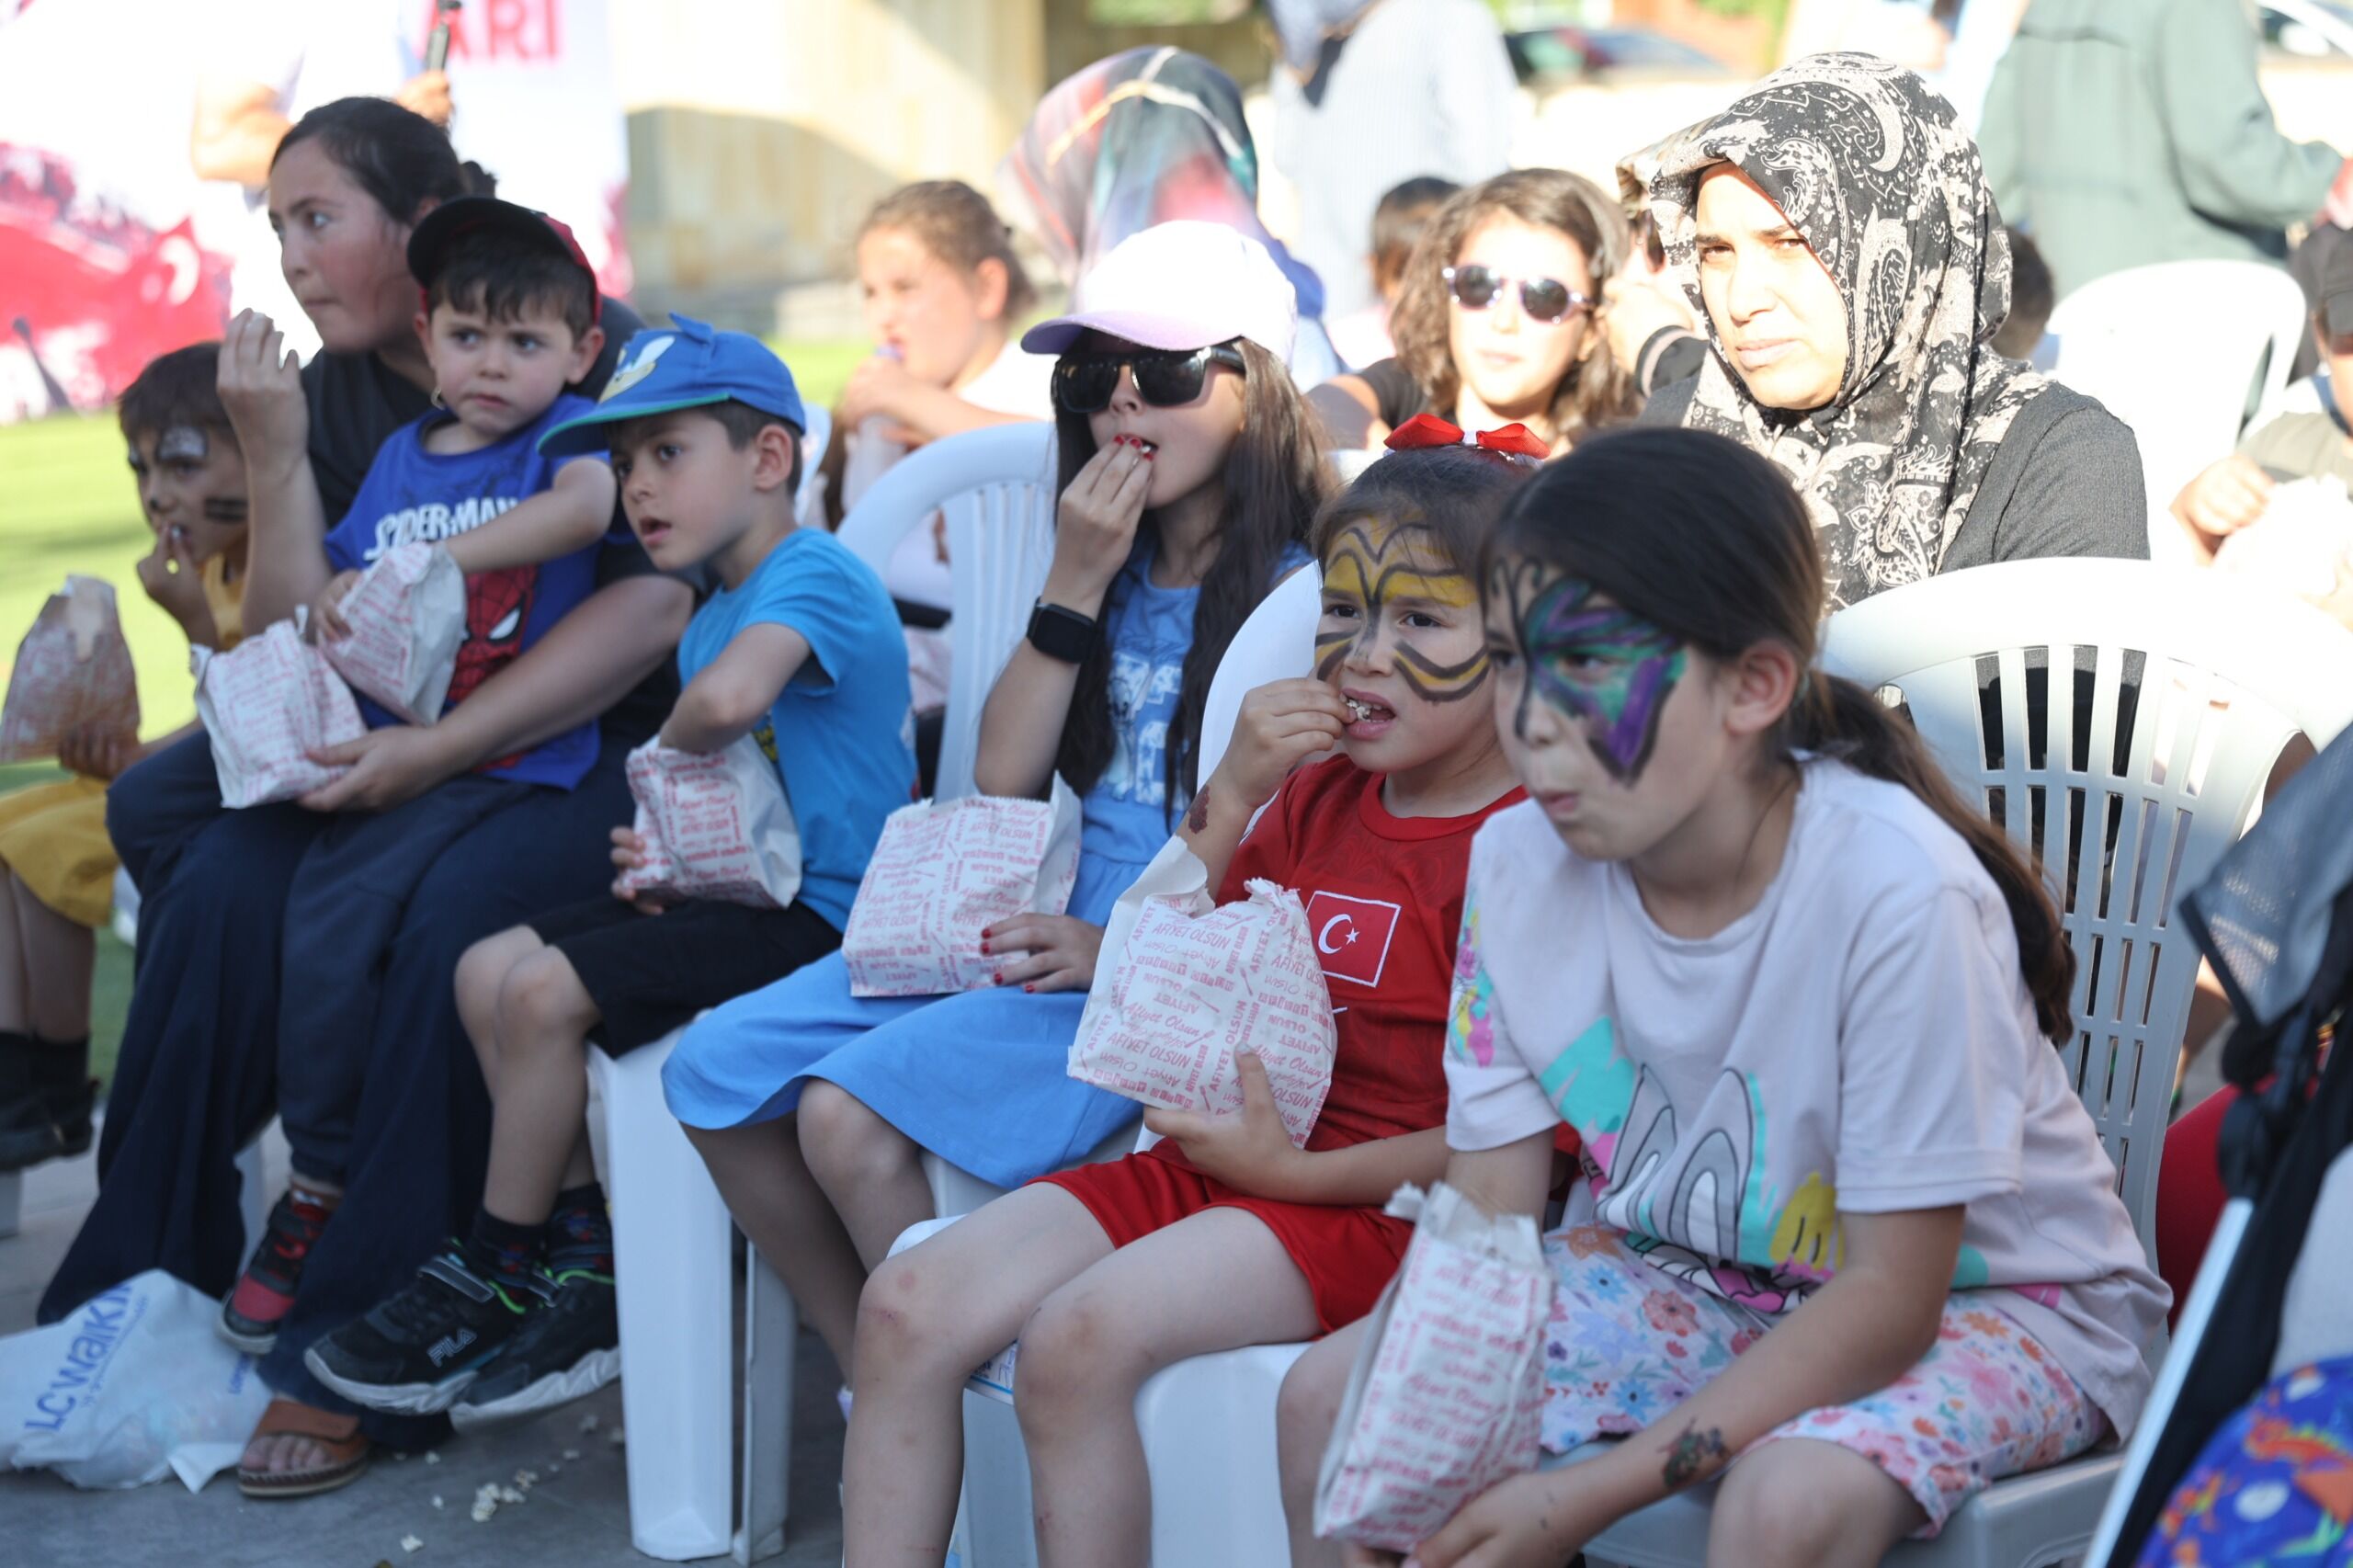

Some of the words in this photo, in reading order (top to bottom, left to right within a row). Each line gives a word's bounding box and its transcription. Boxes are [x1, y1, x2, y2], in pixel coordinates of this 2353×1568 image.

[1152, 922, 1191, 937] AFIYET
[1190, 928, 1231, 949] OLSUN
[1250, 930, 1270, 973] AFIYET
[1271, 955, 1305, 977] AFIYET
[1153, 992, 1199, 1014] AFIYET
[1165, 1016, 1200, 1037] Olsun
[1267, 1015, 1306, 1033] OLSUN
[1107, 1032, 1150, 1054] AFIYET
[1149, 1046, 1191, 1069] OLSUN
[1209, 1049, 1231, 1092] AFIYET
[1225, 1000, 1246, 1045] OLSUN
[1279, 1035, 1321, 1054] AFIYET
[1290, 1057, 1324, 1076] Olsun
[1272, 1088, 1313, 1108] OLSUN
[426, 1328, 477, 1369] FILA
